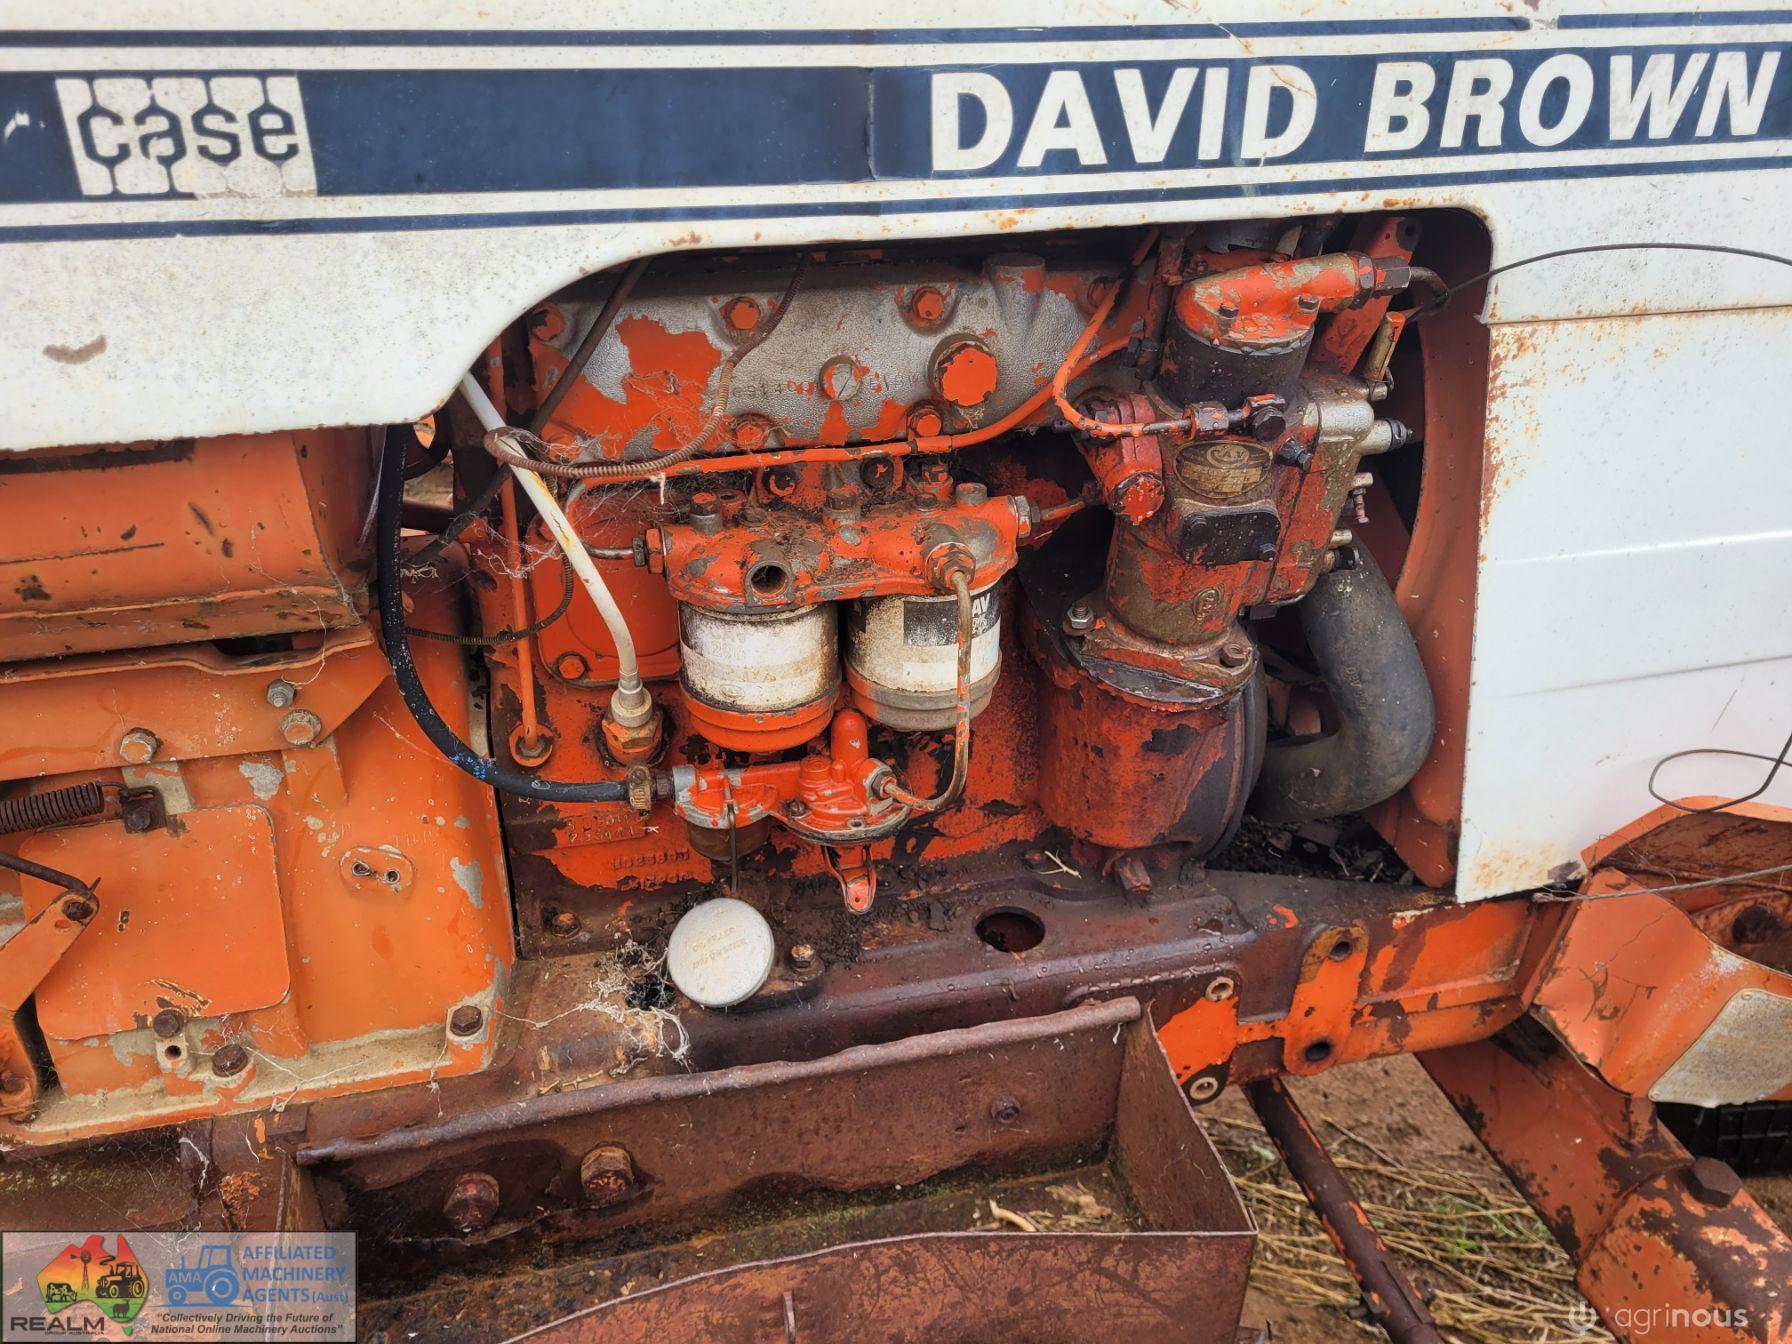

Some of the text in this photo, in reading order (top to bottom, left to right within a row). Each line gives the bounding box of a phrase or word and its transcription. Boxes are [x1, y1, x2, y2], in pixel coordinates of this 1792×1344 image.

[931, 51, 1782, 172] DAVID BROWN
[971, 592, 991, 617] AV
